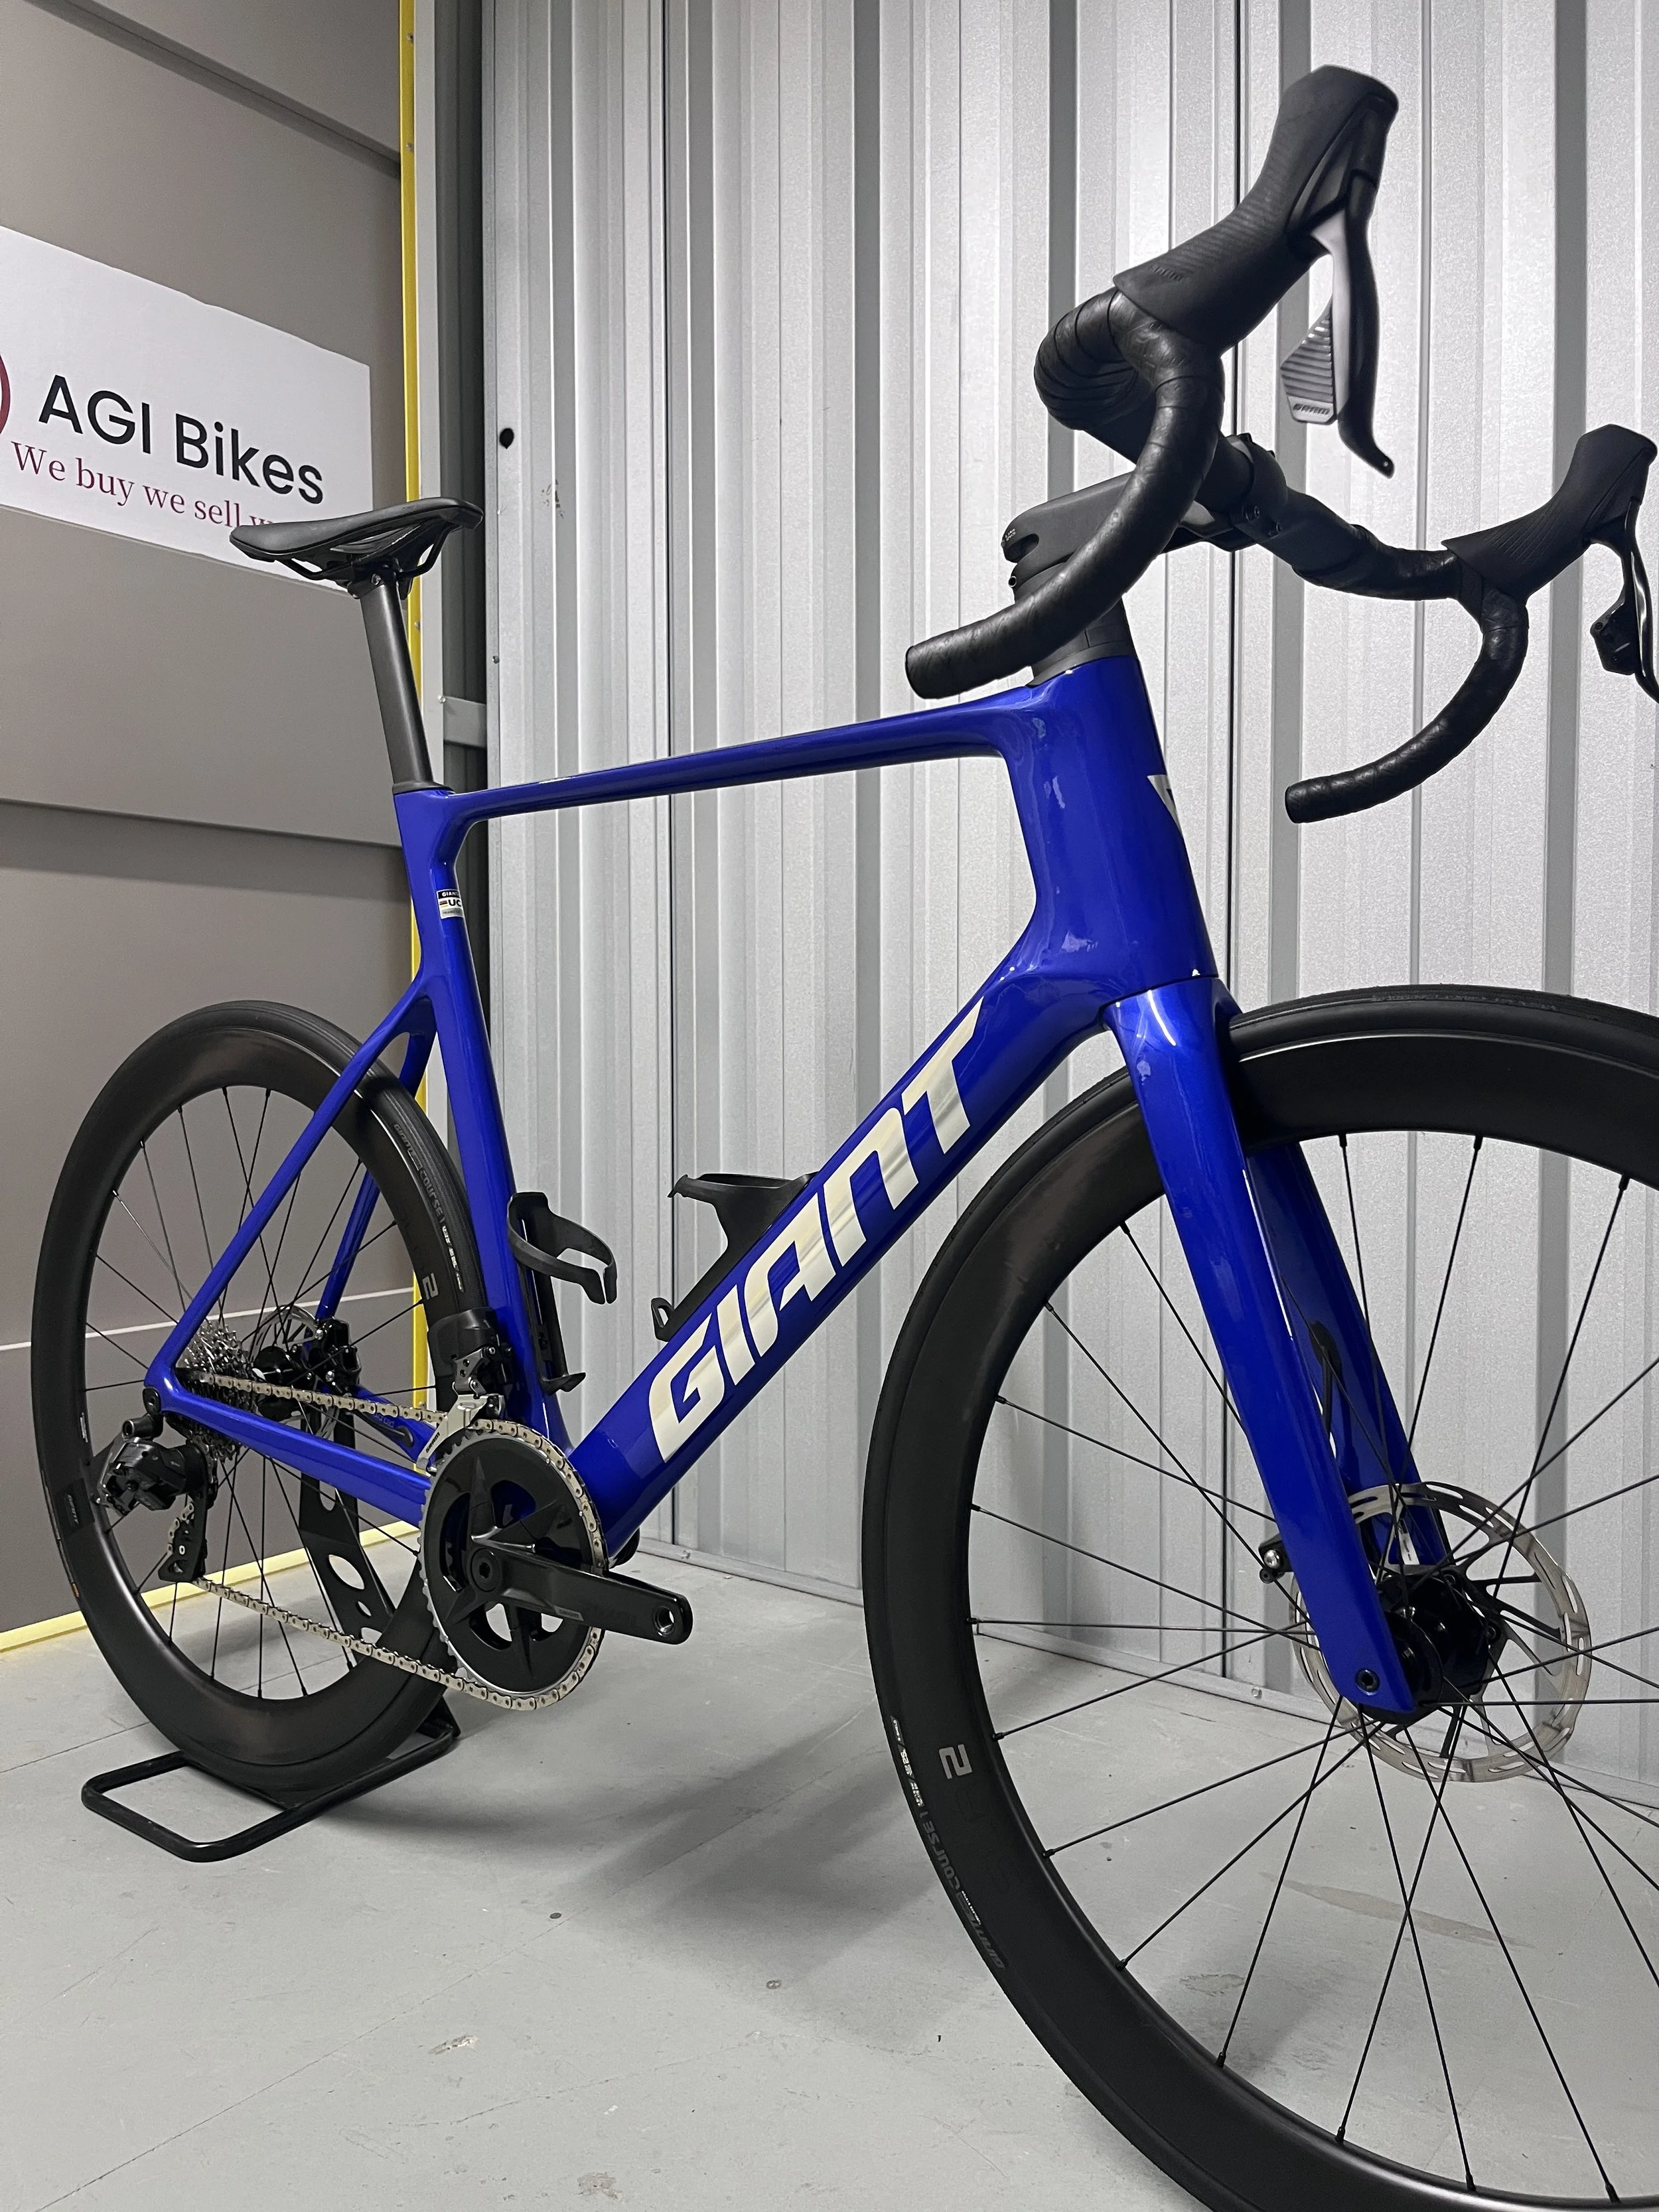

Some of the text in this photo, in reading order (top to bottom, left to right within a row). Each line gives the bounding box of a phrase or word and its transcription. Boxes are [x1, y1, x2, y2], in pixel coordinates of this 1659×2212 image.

[11, 441, 240, 527] We buy we sell
[38, 374, 324, 504] AGI Bikes
[648, 995, 984, 1463] GIANT
[938, 1743, 973, 1779] 2
